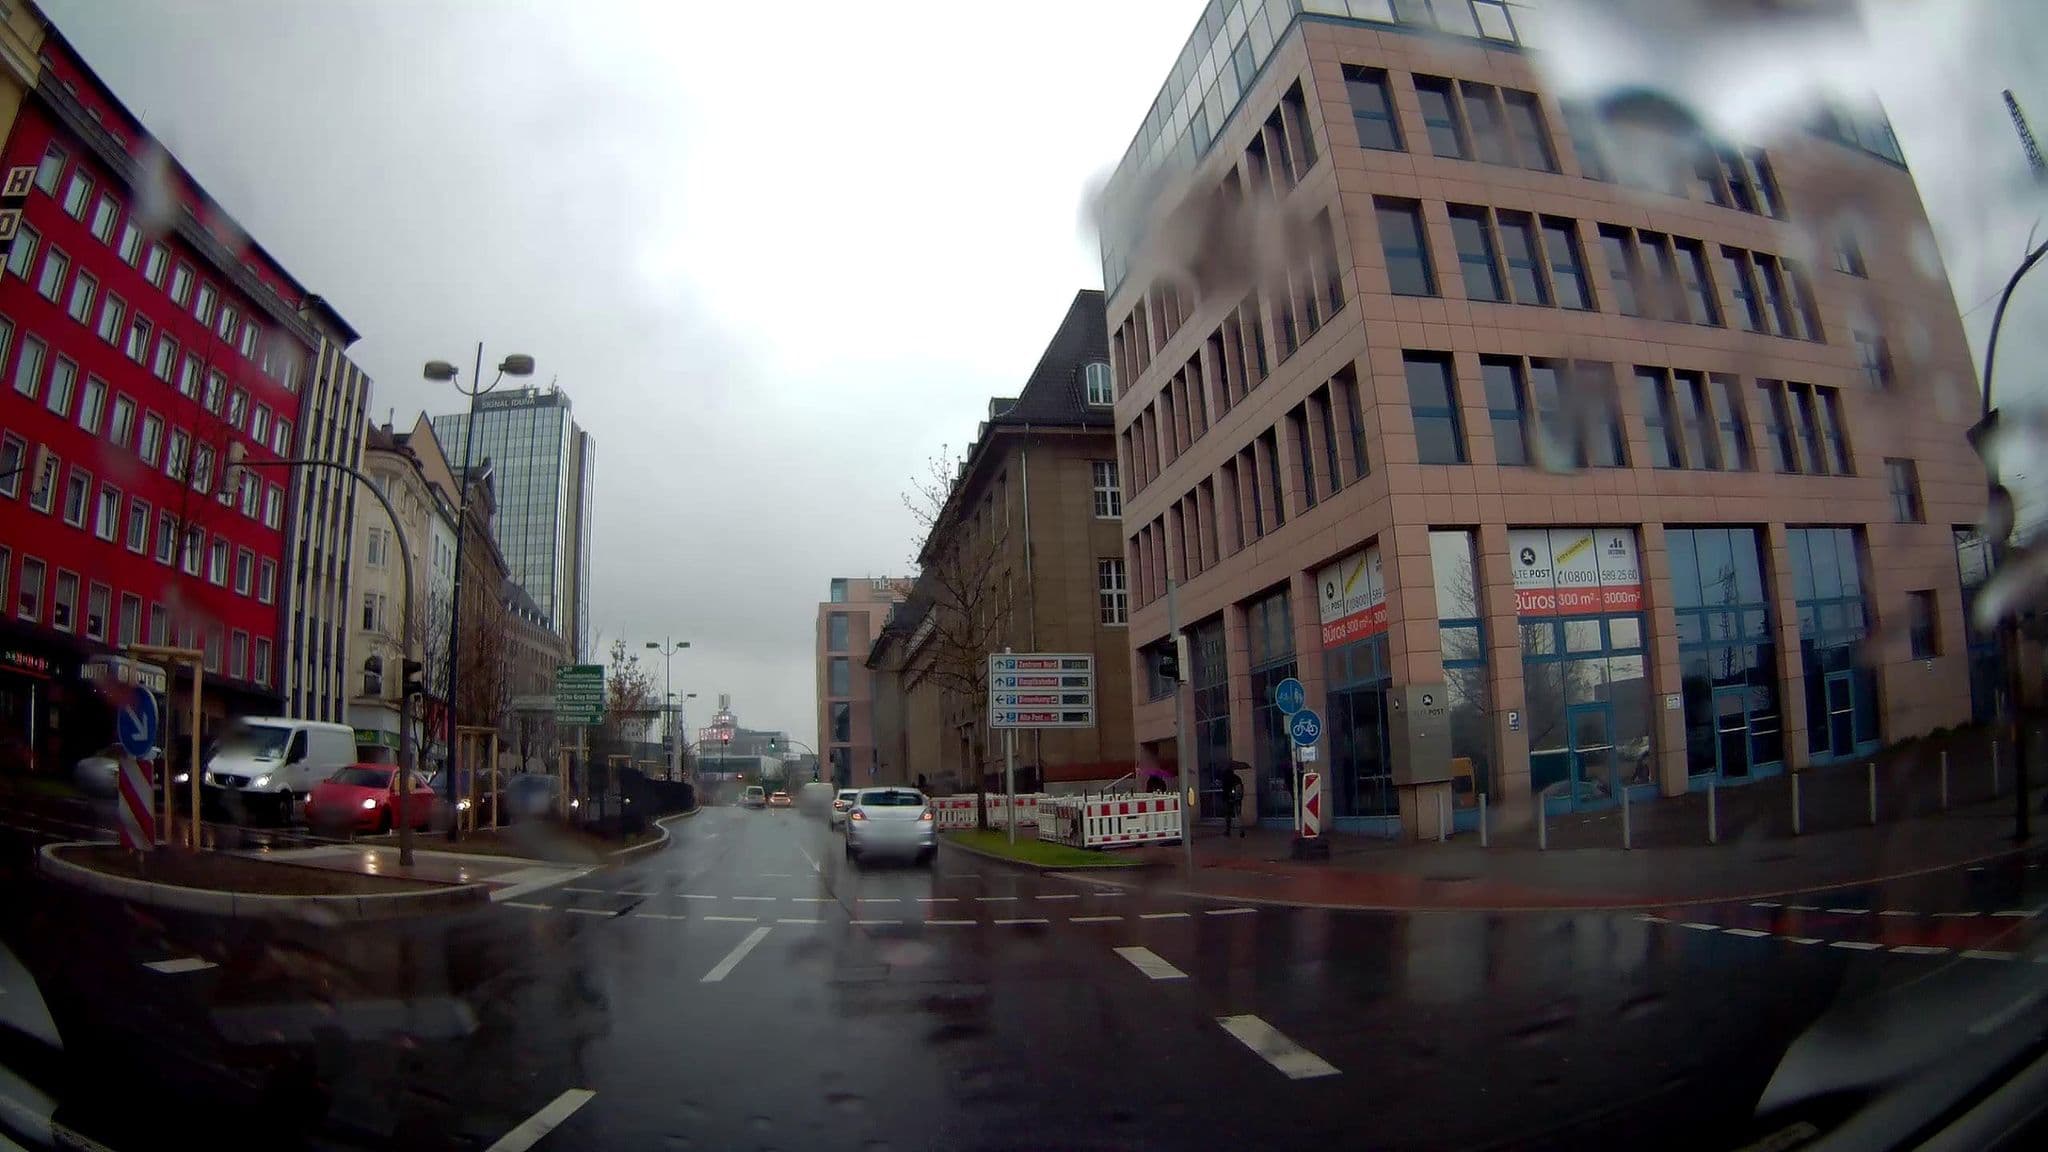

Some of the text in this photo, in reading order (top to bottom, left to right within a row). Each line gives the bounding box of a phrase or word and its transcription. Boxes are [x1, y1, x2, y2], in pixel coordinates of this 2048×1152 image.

[482, 397, 535, 409] SIGNAL IDUNA
[1529, 568, 1550, 578] POST
[1564, 570, 1597, 584] (0800)
[1602, 569, 1616, 580] 589
[1617, 569, 1628, 580] 25
[1558, 593, 1578, 606] 300
[1322, 624, 1346, 643] Büros
[1346, 619, 1359, 634] 300
[1428, 708, 1444, 716] POST
